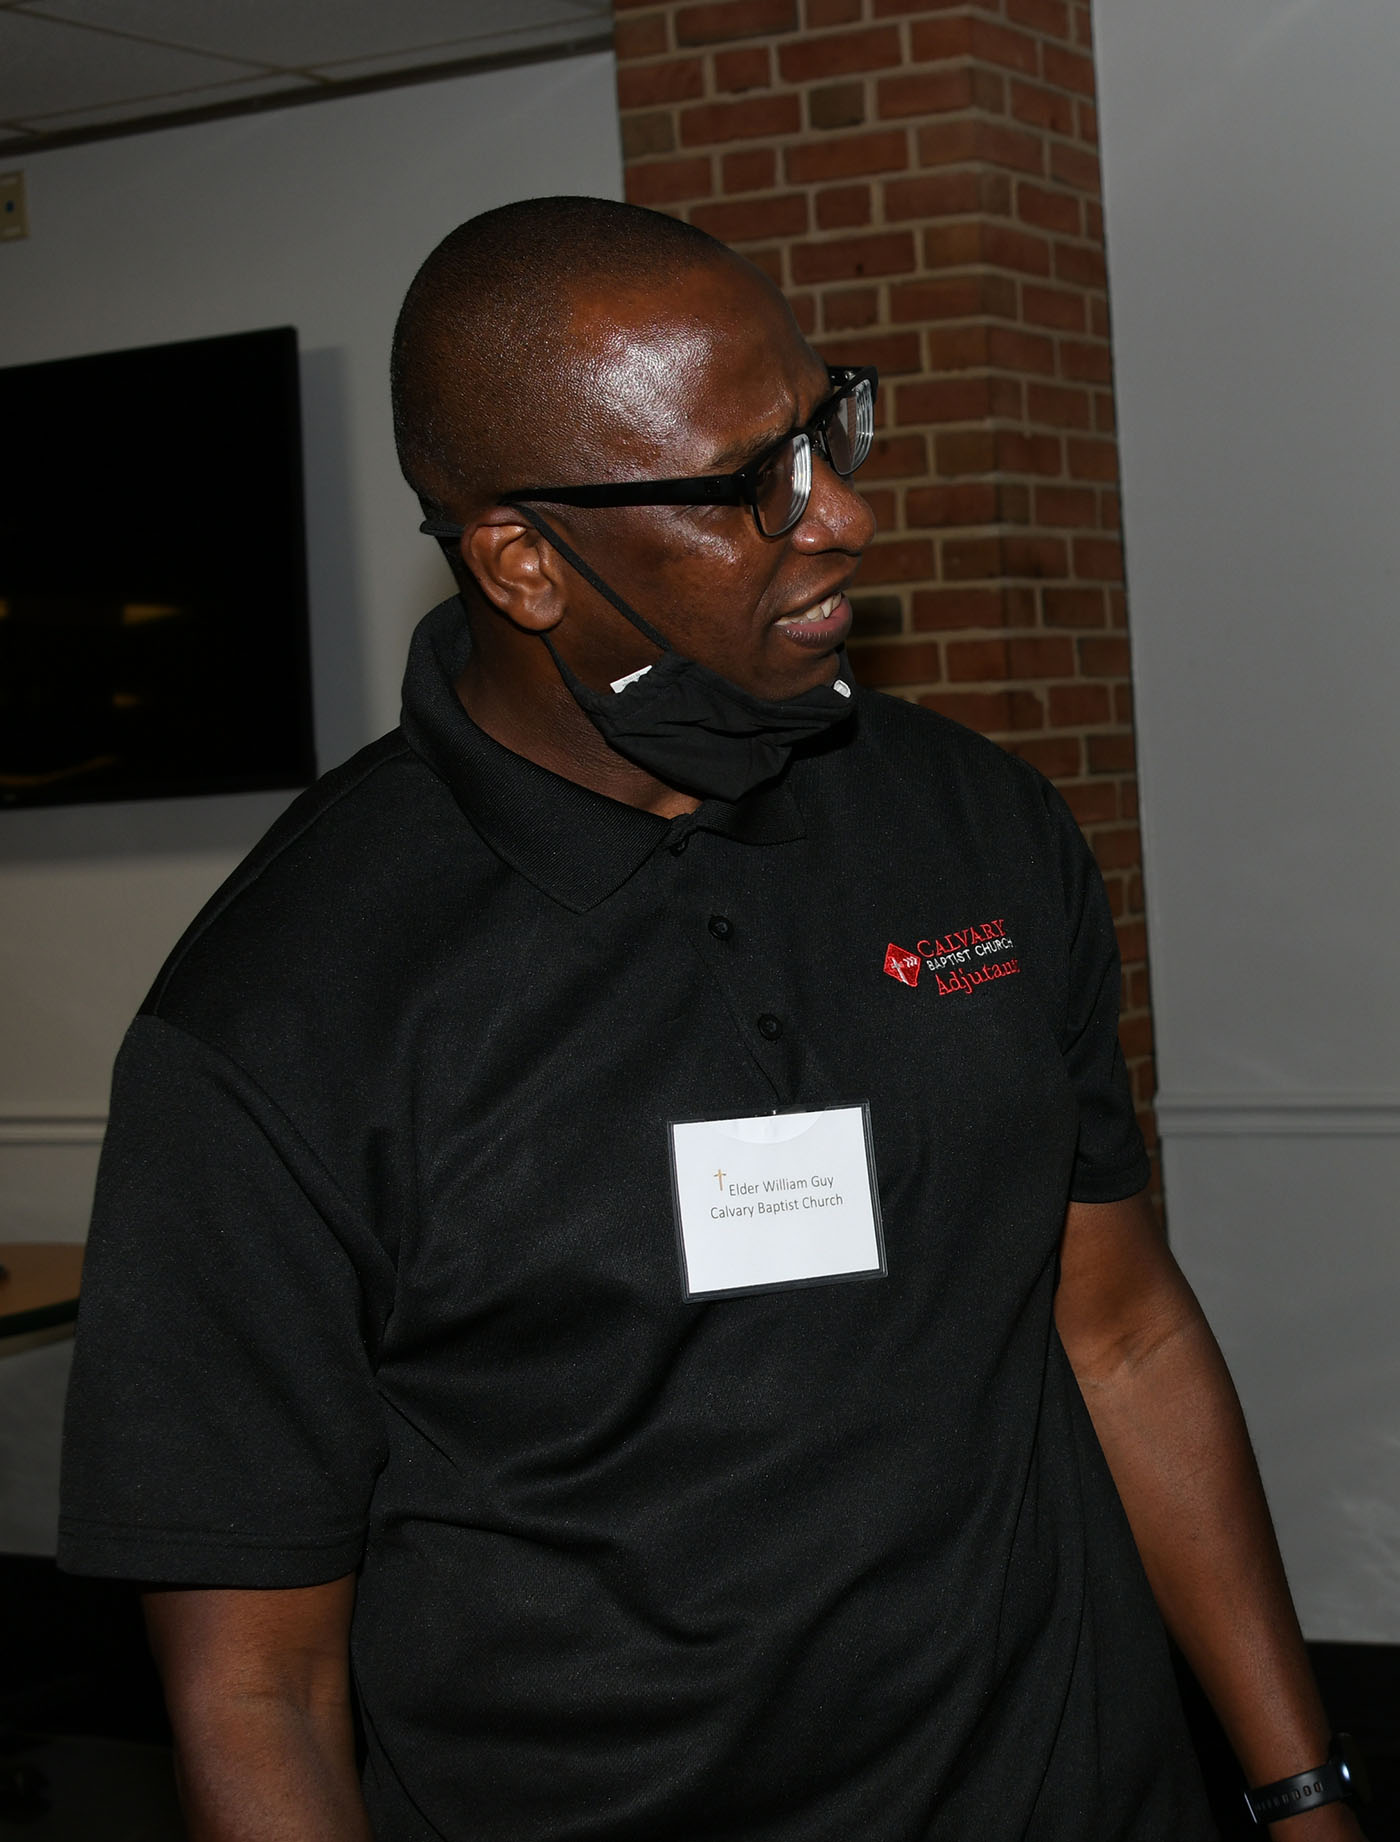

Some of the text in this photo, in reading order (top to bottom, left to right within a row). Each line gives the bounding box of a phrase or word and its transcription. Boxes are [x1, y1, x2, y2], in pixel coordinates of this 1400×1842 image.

[926, 949, 972, 971] BAPTIST
[728, 1175, 834, 1197] Elder William Guy
[710, 1193, 844, 1220] Calvary Baptist Church
